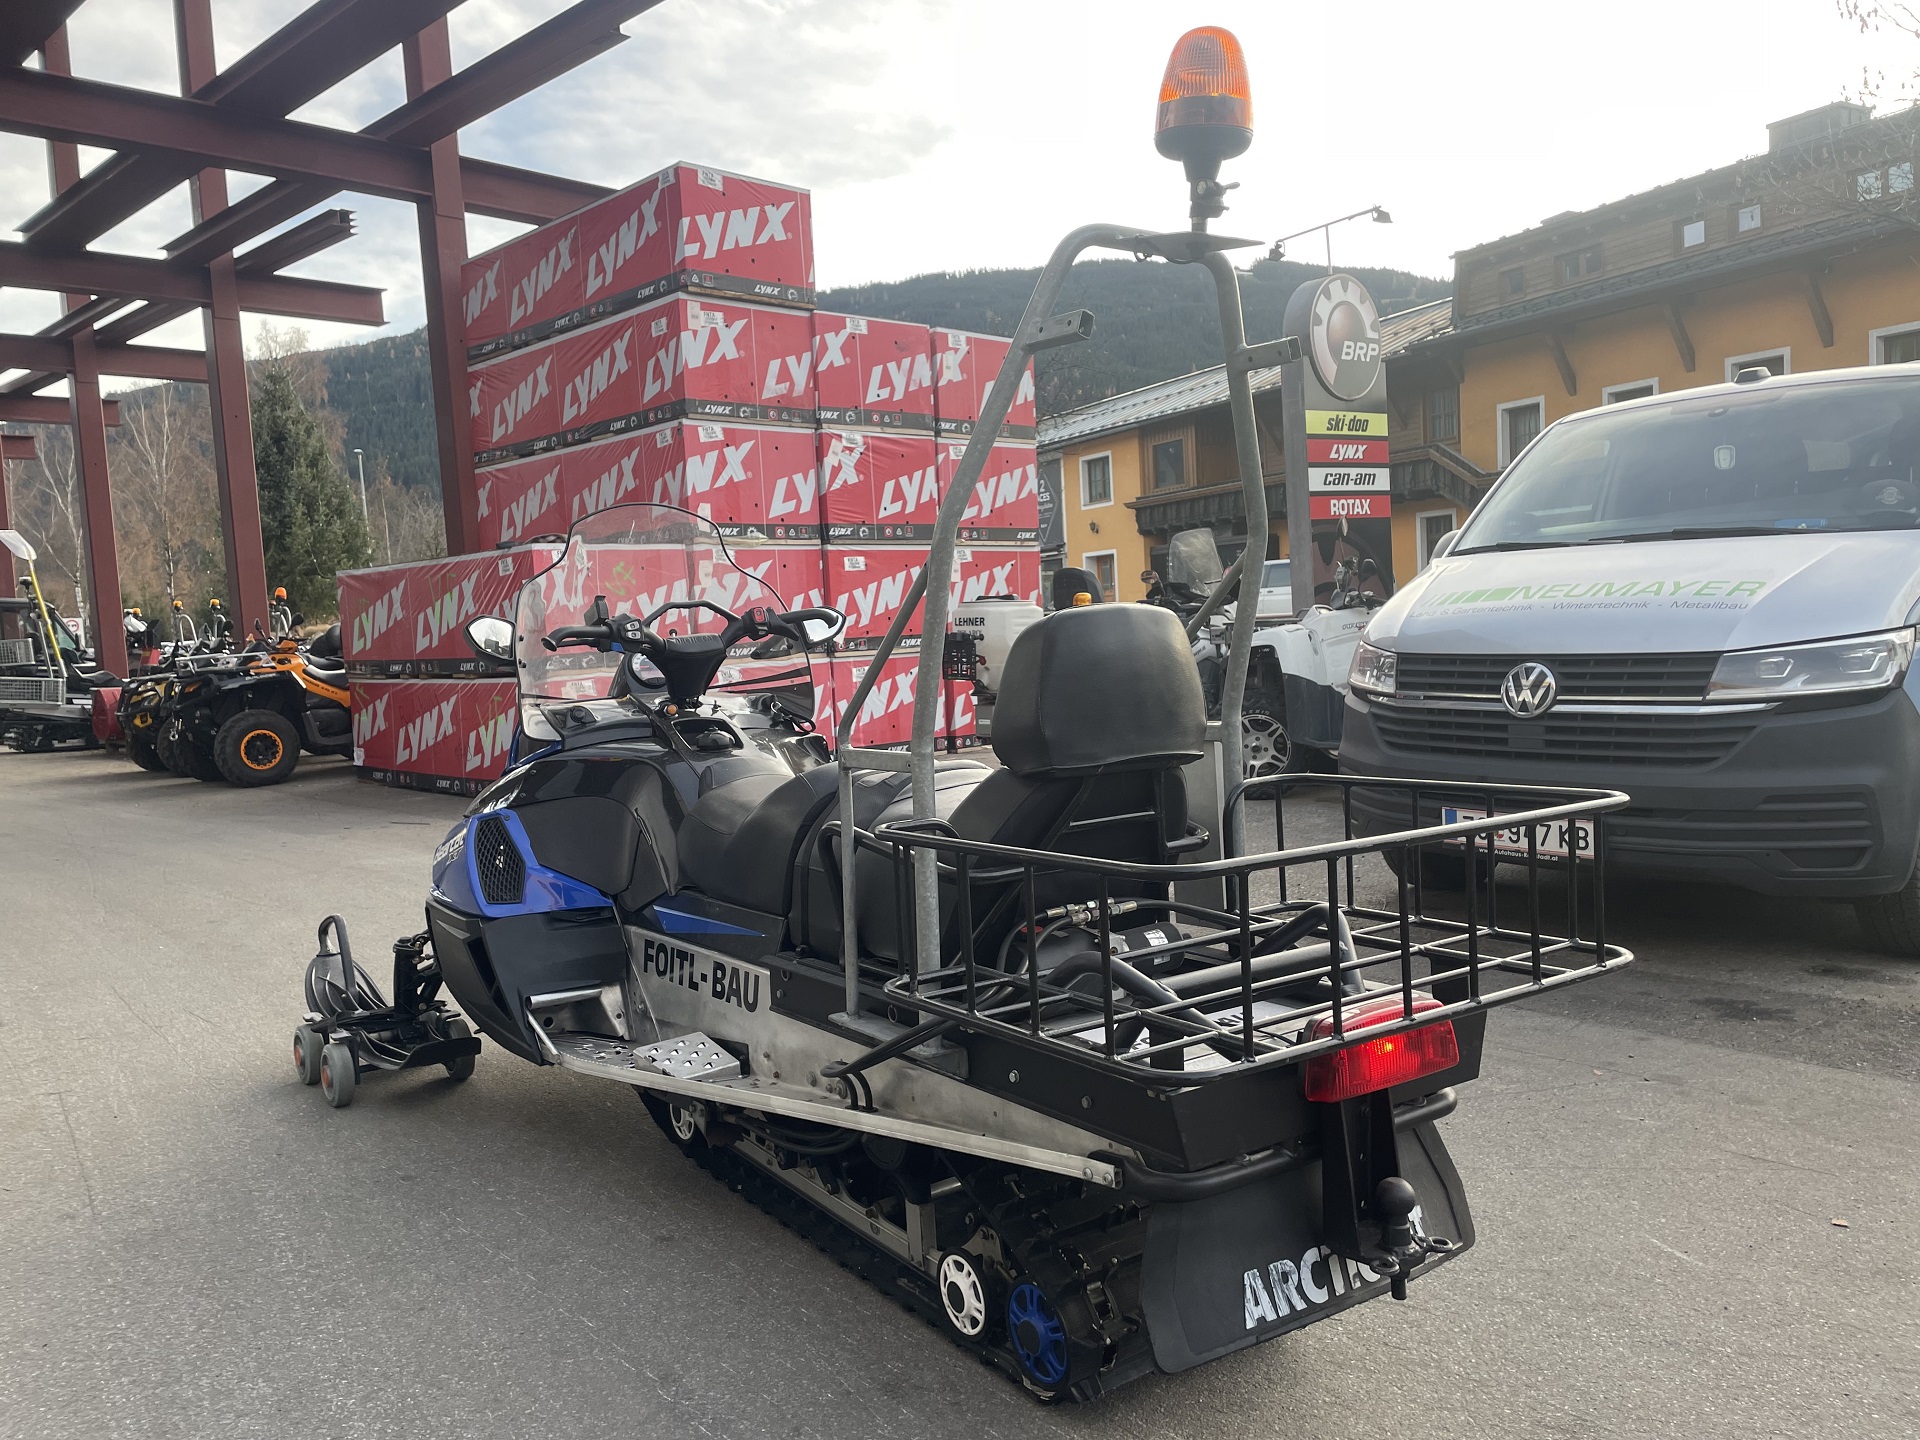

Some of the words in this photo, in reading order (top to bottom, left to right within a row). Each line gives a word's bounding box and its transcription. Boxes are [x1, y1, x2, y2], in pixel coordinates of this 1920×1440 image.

[586, 187, 661, 299] LYNX
[674, 201, 795, 266] LYNX
[510, 226, 576, 328] LYNX
[637, 285, 655, 299] LYNX
[754, 284, 781, 296] LYNX
[643, 319, 748, 404] LYNX
[1341, 341, 1380, 362] BRP
[563, 327, 632, 425] LYNX
[492, 354, 552, 443] LYNX
[704, 404, 733, 415] LYNX
[816, 409, 840, 420] LYNX
[1326, 414, 1370, 433] ski-doo
[1329, 444, 1367, 460] LYNX
[652, 440, 756, 520] LYNX
[1323, 472, 1376, 486] can-am
[501, 464, 560, 542] LYNX
[1330, 499, 1371, 515] ROTAX
[829, 526, 853, 536] LYNX
[1016, 531, 1037, 539] LYNX
[1508, 581, 1767, 600] NEUMAYER
[353, 579, 406, 655] LYNX
[416, 569, 480, 654] LYNX
[1452, 603, 1534, 615] Gartentechnik
[1552, 601, 1650, 610] Wintertechnik
[1670, 601, 1749, 610] Metallbau
[954, 617, 985, 626] LEHNER
[397, 694, 458, 765] LYNX
[643, 938, 760, 1013] FOITL-BAU
